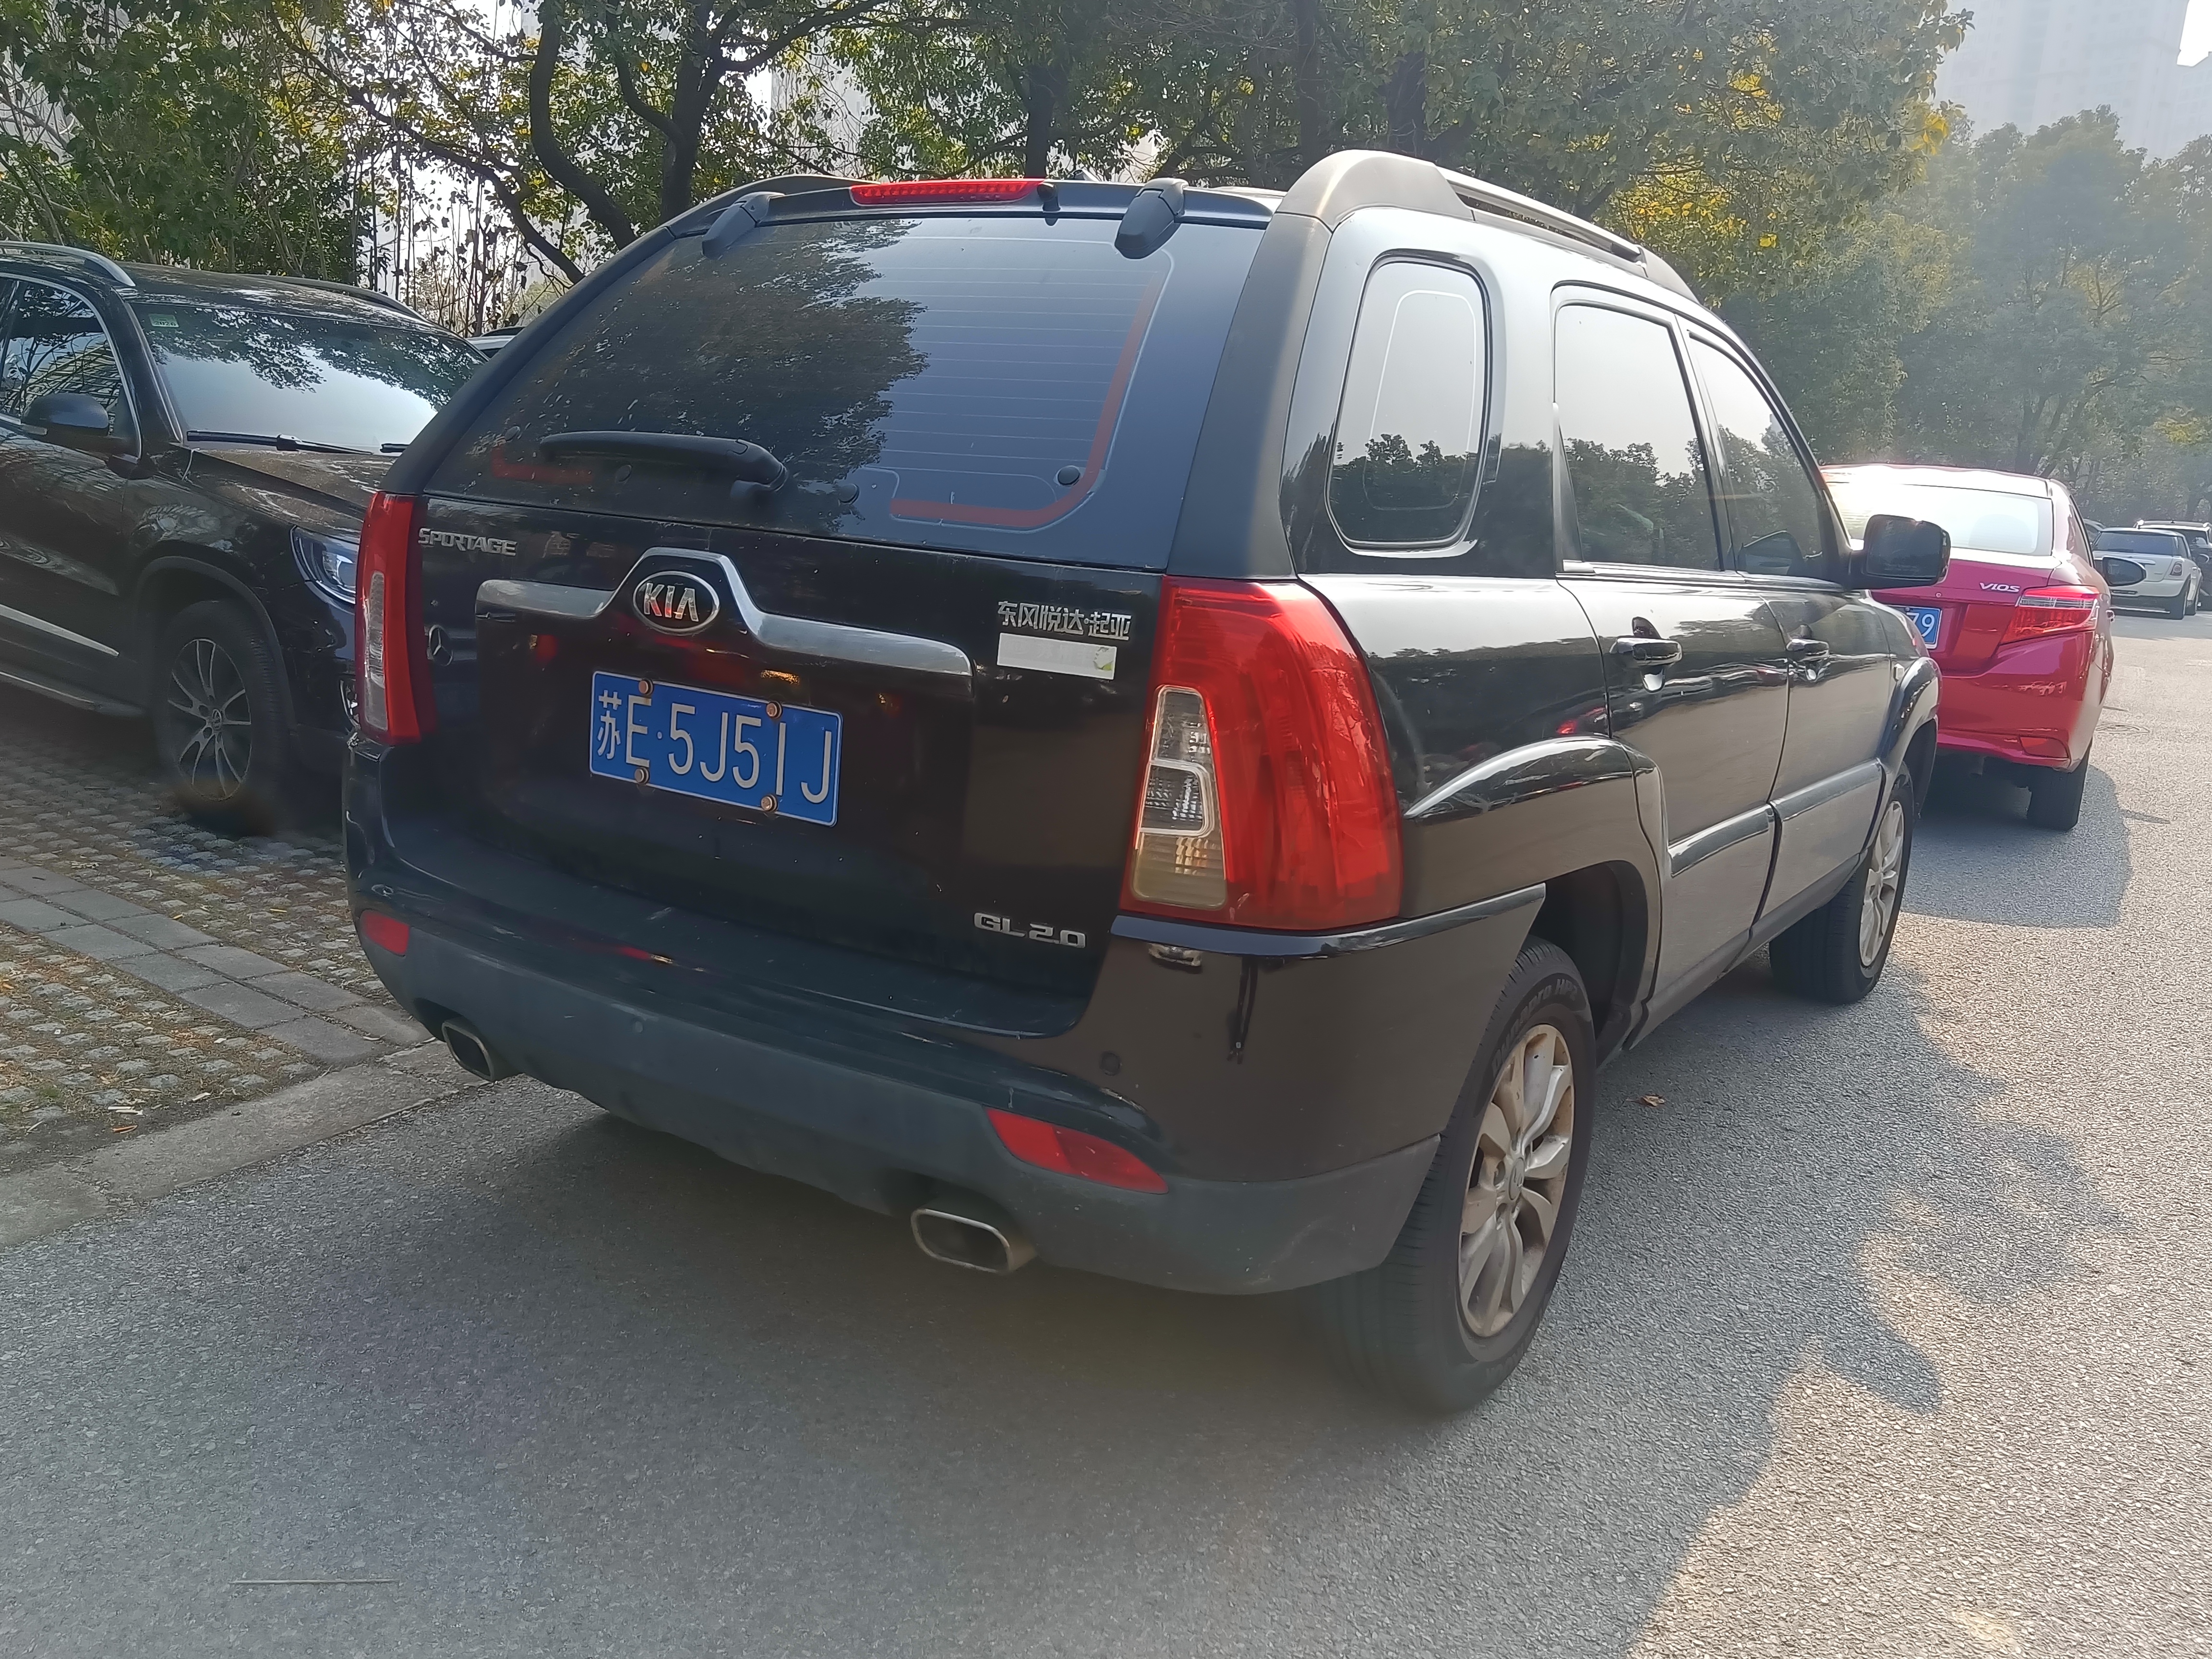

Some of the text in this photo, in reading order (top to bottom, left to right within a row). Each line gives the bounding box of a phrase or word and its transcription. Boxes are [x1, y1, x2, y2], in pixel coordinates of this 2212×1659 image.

[418, 528, 518, 556] SPORTAGE
[1980, 582, 2020, 592] VIOS
[644, 582, 699, 622] KIA
